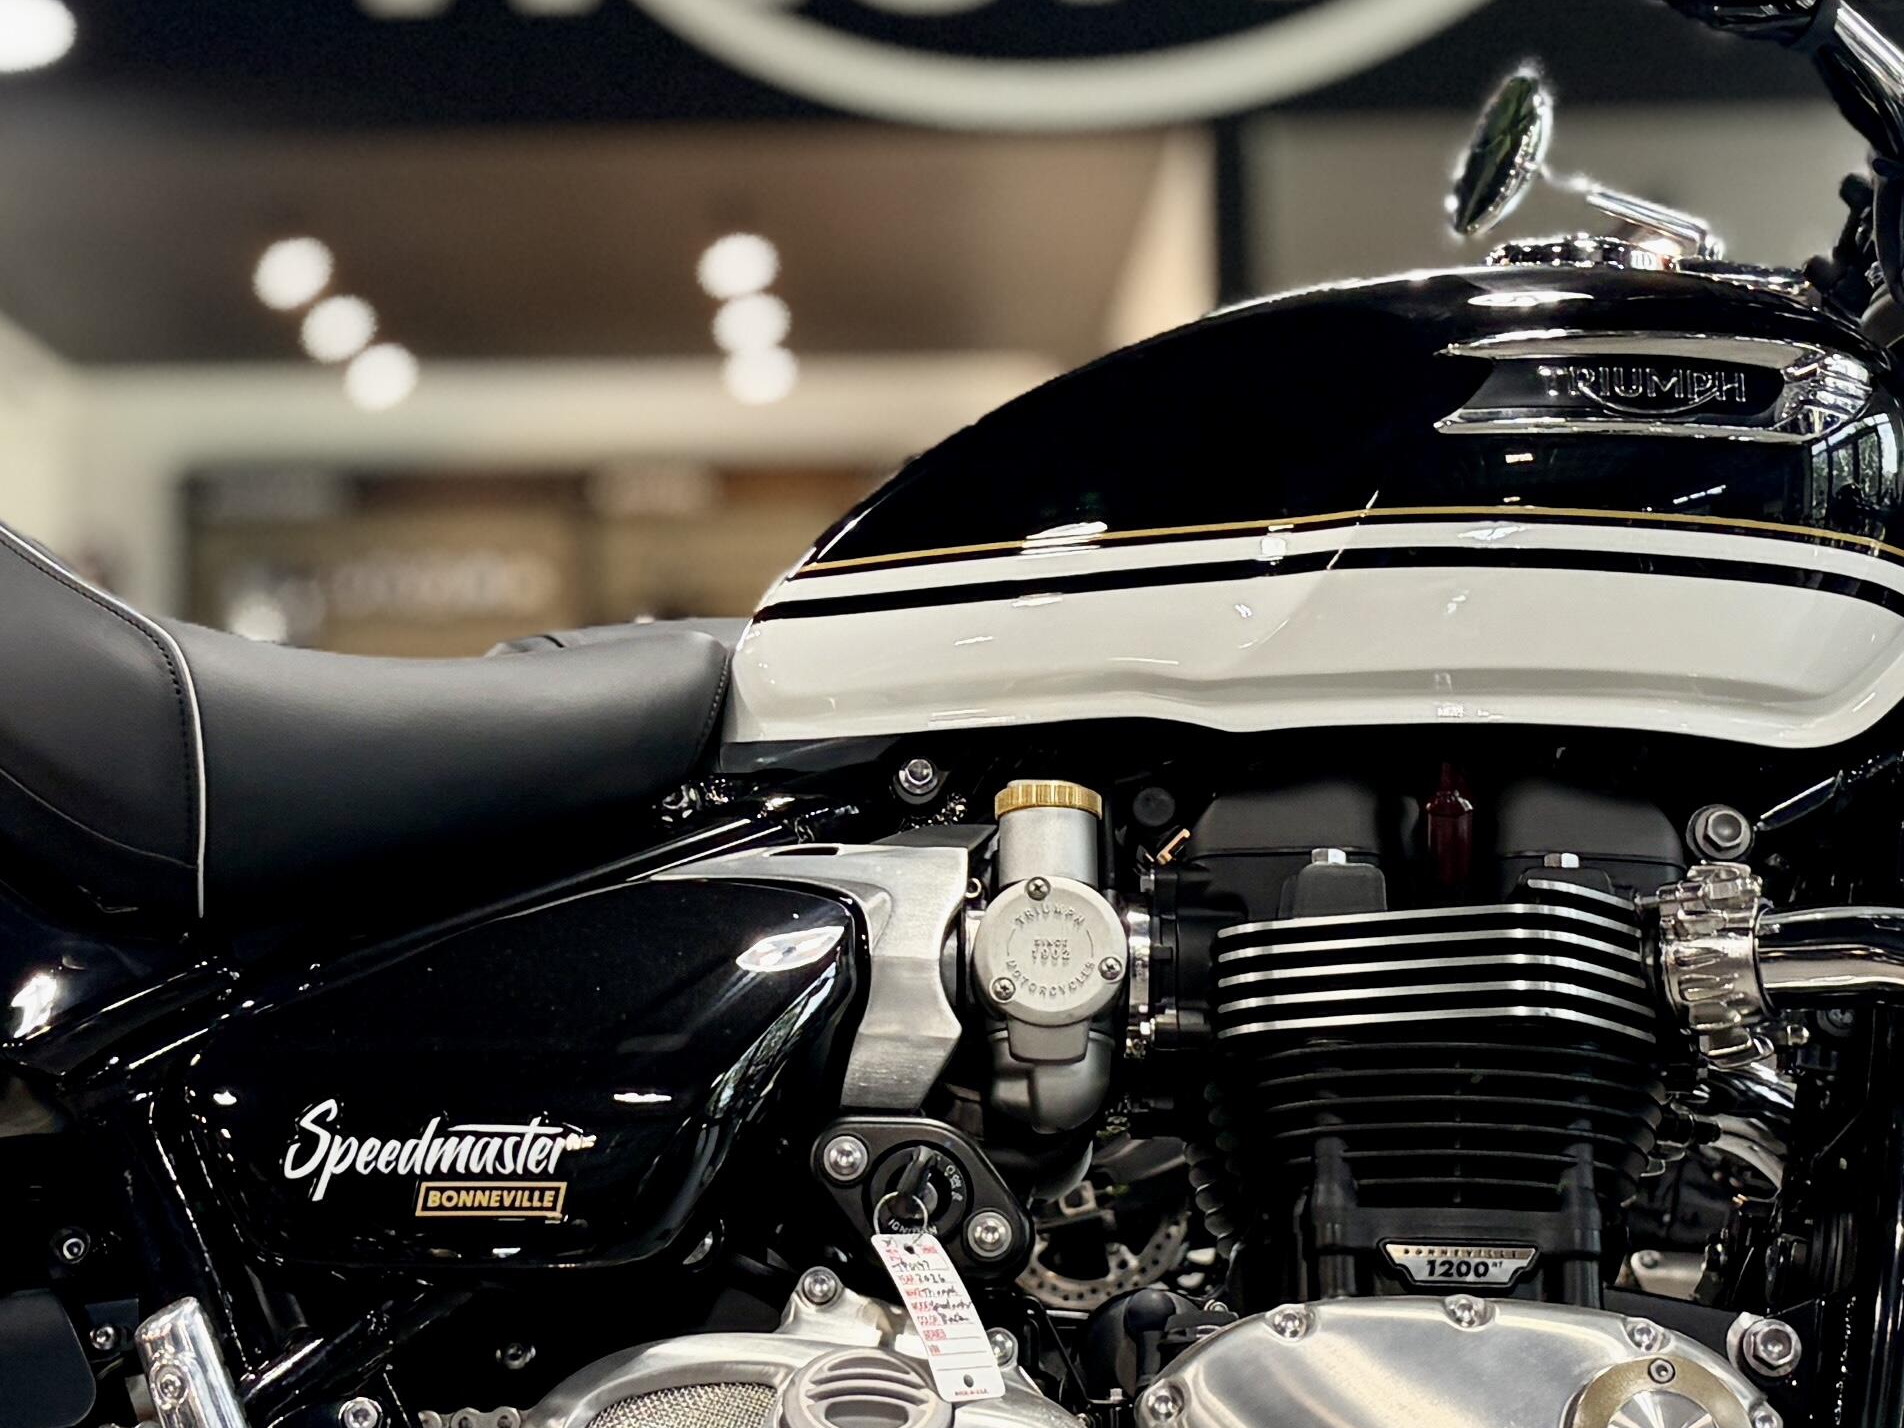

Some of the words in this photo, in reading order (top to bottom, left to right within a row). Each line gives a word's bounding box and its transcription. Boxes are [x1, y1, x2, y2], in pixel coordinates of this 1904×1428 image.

[1537, 365, 1747, 414] TRIUMPH
[1014, 903, 1086, 929] TRIUMPH
[1005, 958, 1096, 999] MOTORCYCLES
[284, 1098, 570, 1201] Speedmaster
[426, 1189, 556, 1208] BONNEVILLE
[1426, 1259, 1490, 1278] 1200
